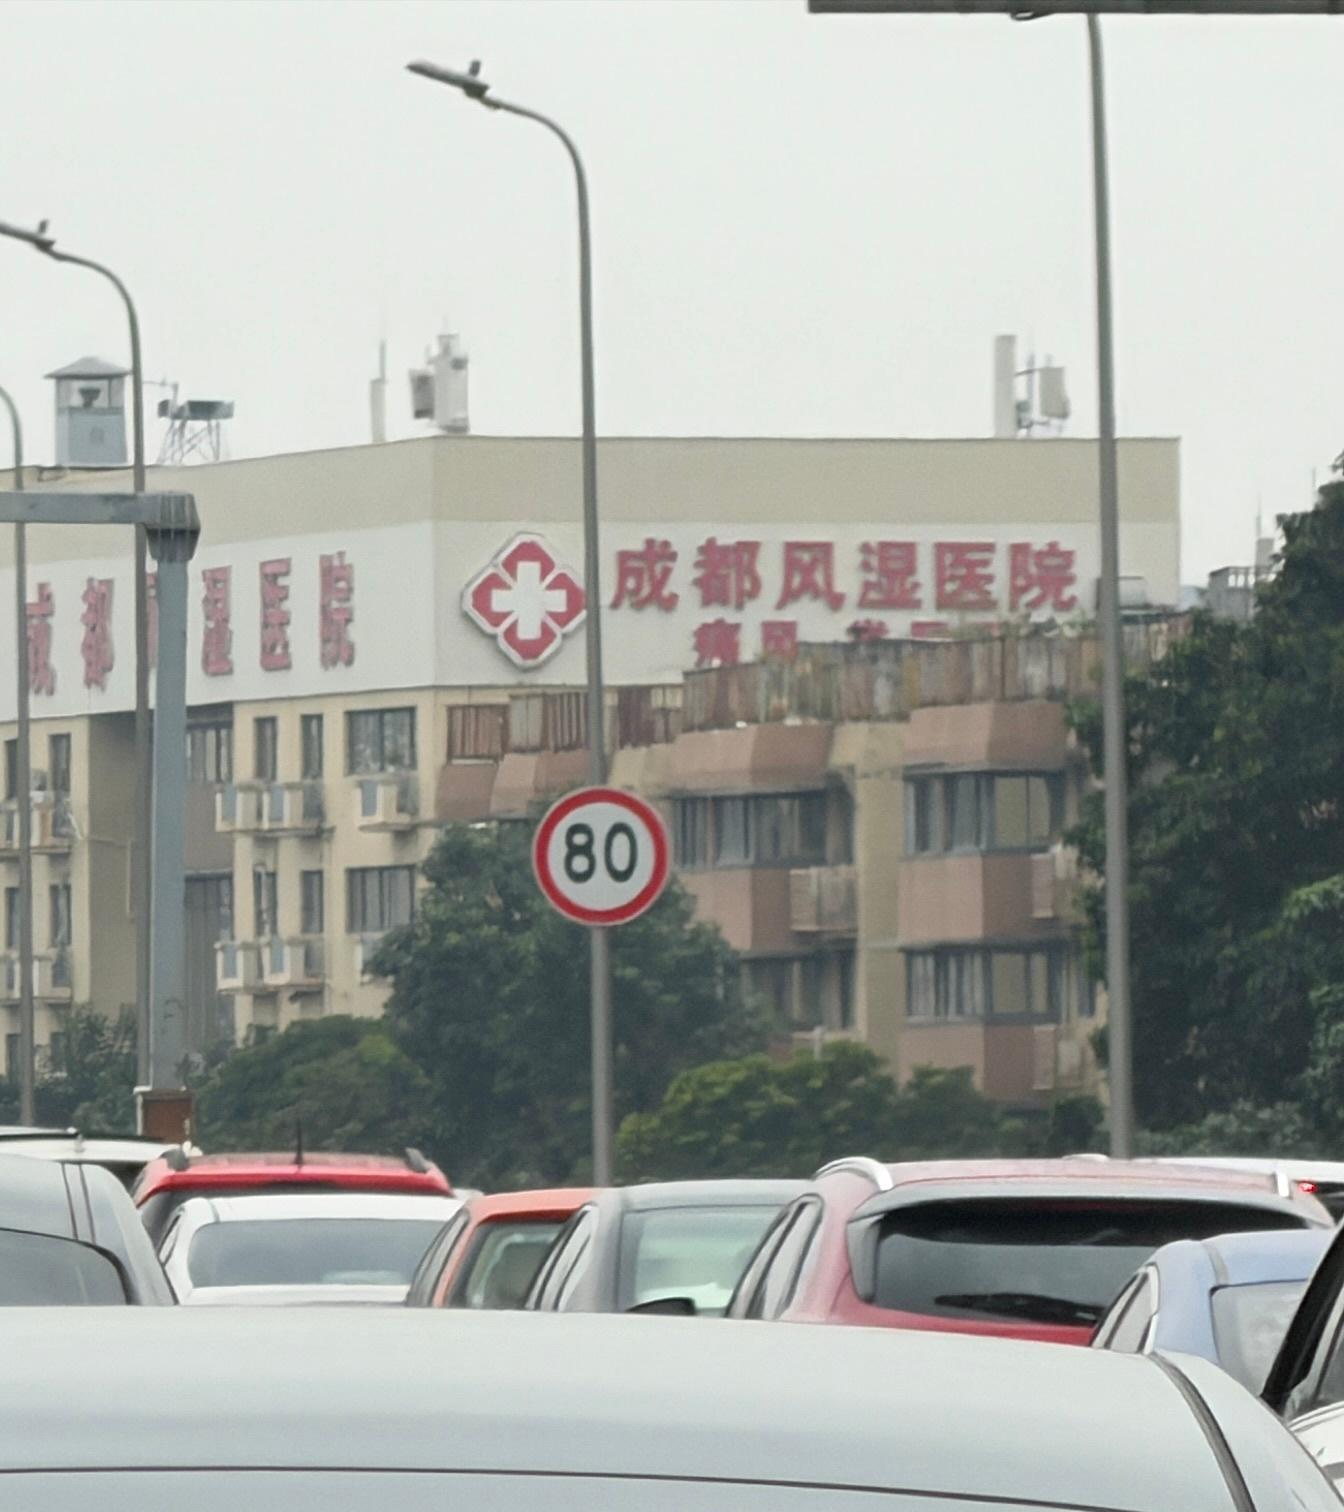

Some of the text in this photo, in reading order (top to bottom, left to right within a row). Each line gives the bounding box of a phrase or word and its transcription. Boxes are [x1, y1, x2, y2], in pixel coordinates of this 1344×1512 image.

[610, 536, 1079, 613] 成都风湿医院
[24, 551, 355, 697] 成都湿医院
[563, 822, 639, 884] 80
